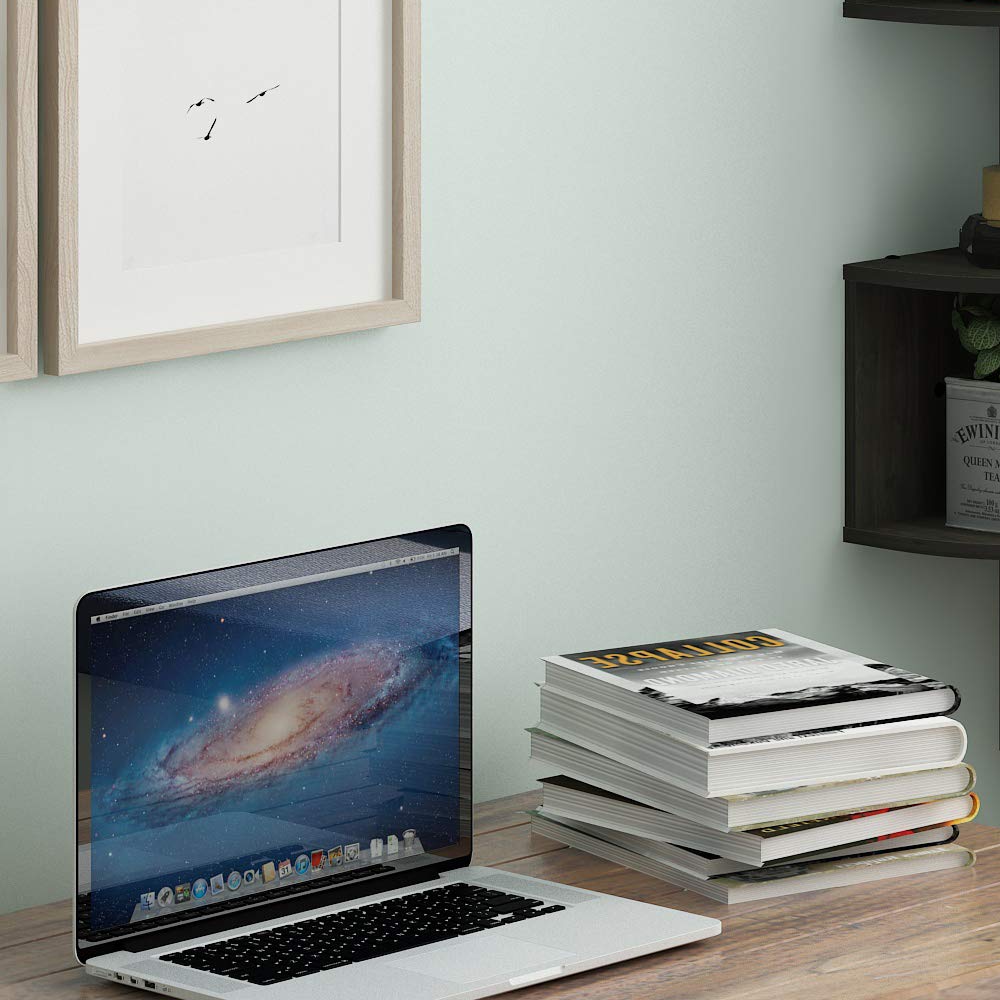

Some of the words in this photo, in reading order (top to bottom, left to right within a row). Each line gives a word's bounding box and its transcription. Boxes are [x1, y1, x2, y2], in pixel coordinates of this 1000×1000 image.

[963, 455, 993, 468] QUEEN
[984, 471, 1000, 482] TEA
[281, 866, 289, 875] 31
